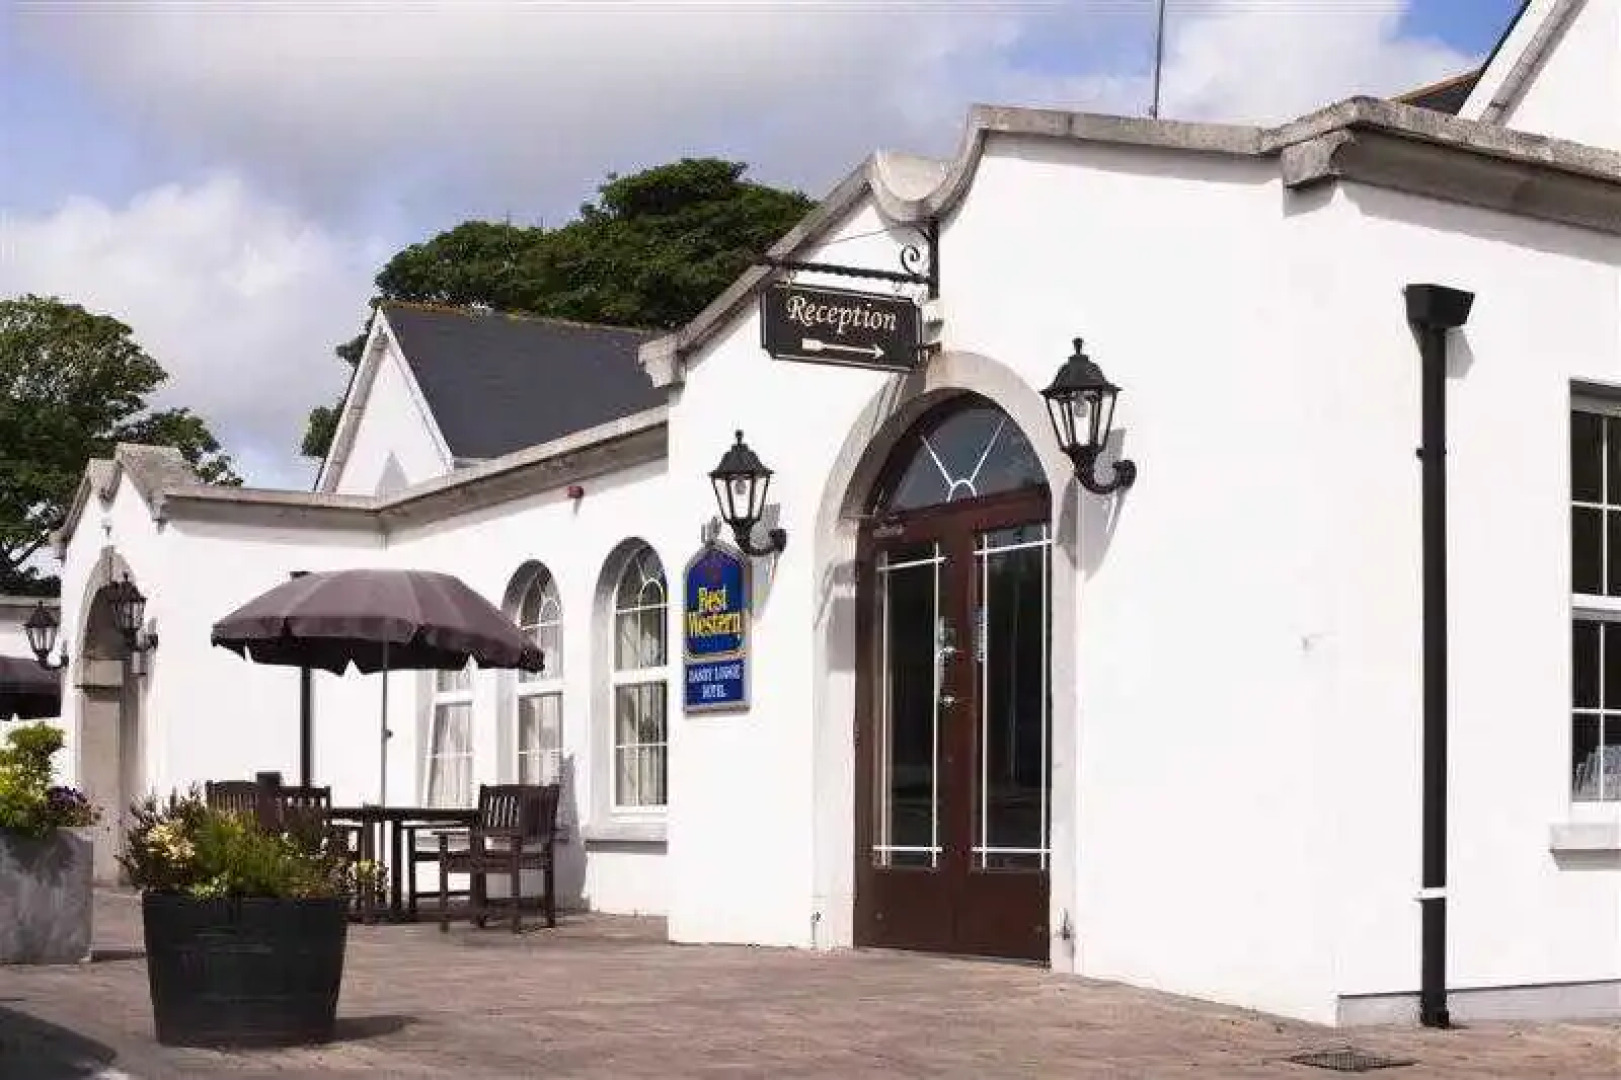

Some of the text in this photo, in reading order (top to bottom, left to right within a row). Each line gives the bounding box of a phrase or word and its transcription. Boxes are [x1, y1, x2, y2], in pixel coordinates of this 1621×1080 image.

[787, 295, 897, 334] Reception
[698, 586, 727, 612] Best
[687, 611, 741, 637] Western
